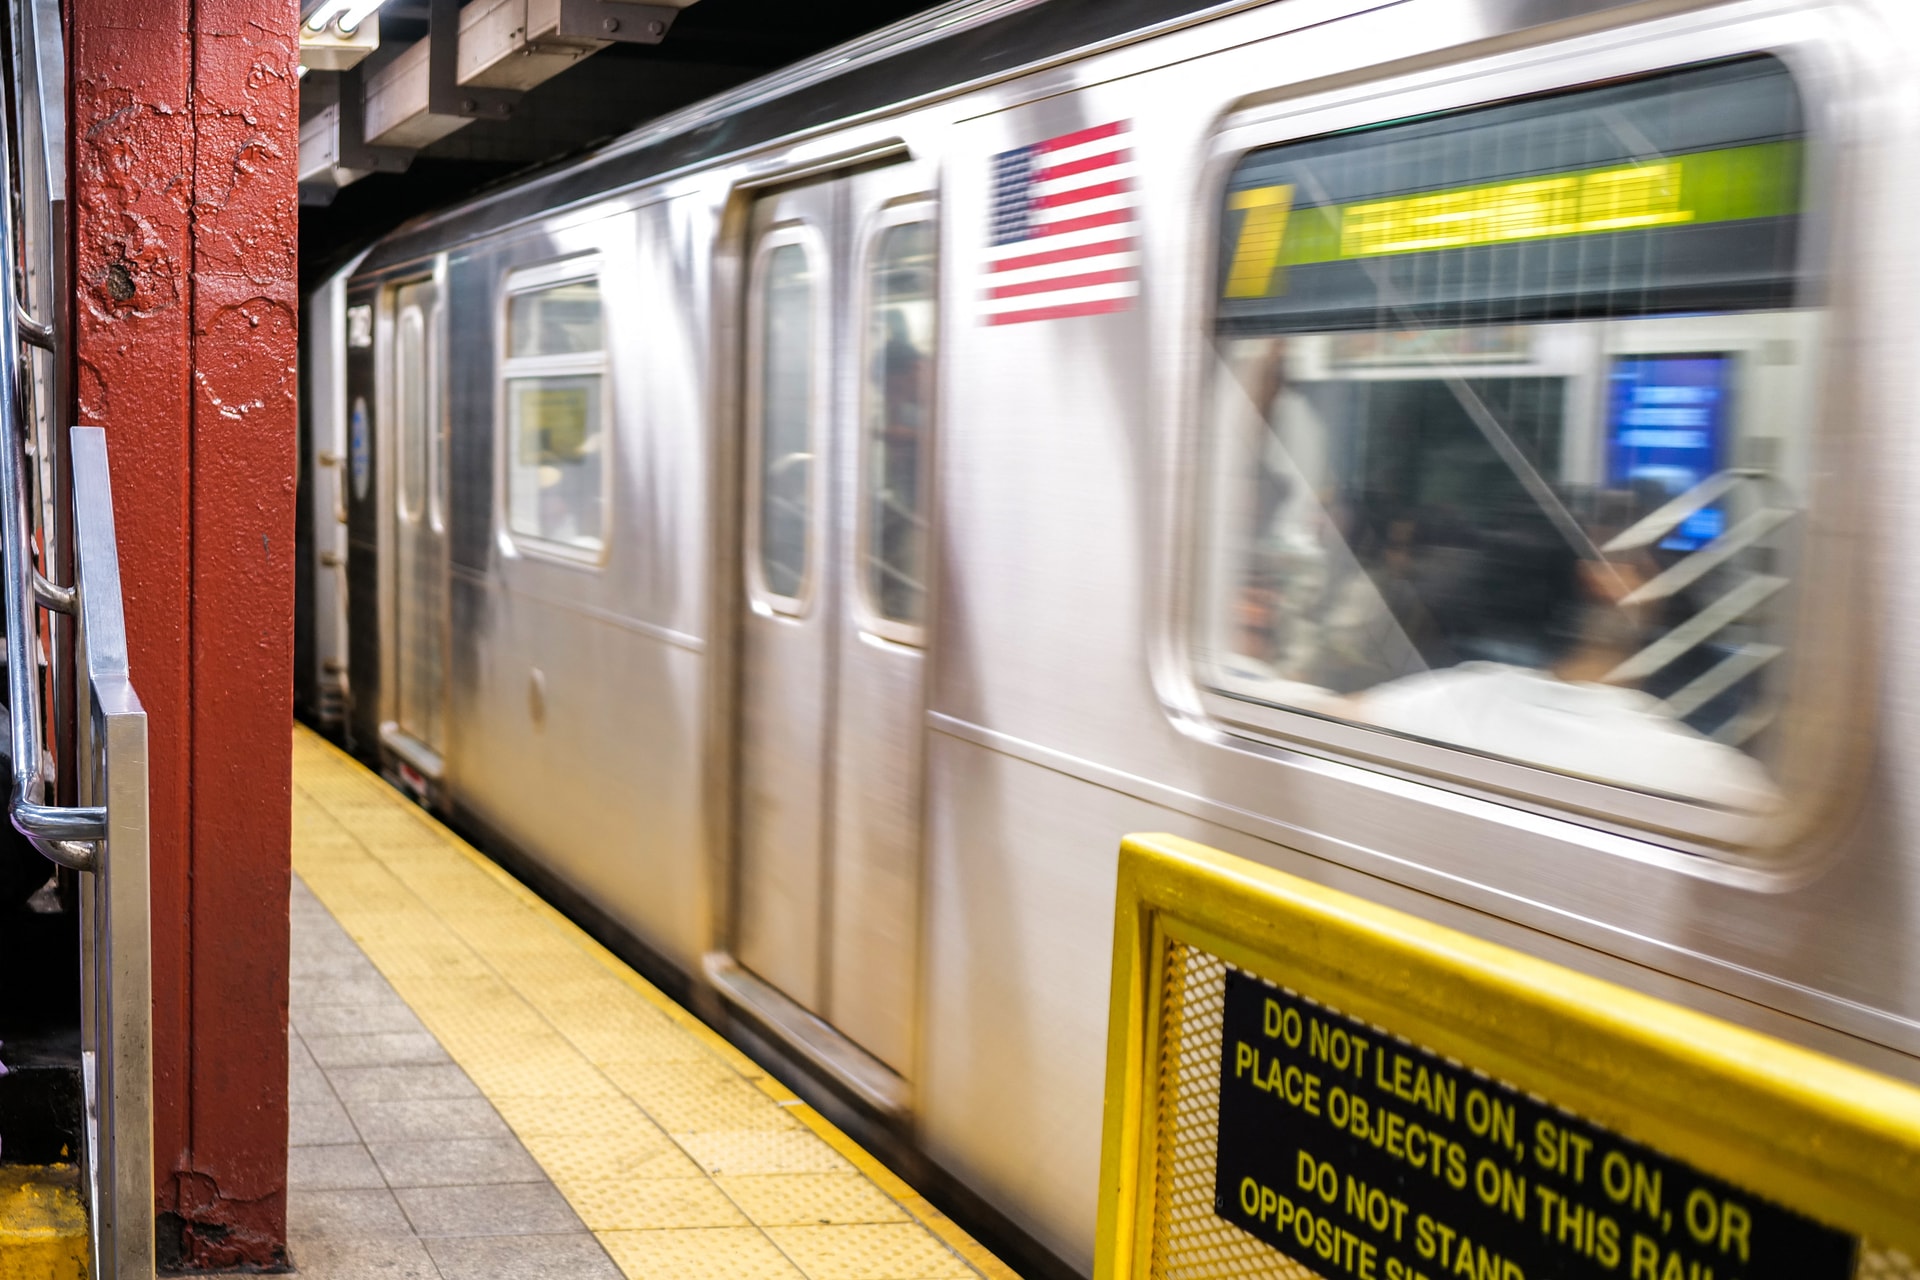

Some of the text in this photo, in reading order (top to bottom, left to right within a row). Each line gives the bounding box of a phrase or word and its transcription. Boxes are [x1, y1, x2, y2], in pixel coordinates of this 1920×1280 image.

[1235, 1040, 1321, 1116] PLACE
[1328, 1086, 1467, 1188] OBJECTS
[1475, 1158, 1526, 1221] ON
[1535, 1183, 1620, 1268] THIS
[1264, 998, 1751, 1261] DO NOT LEAN ON, SIT ON, OR
[1297, 1149, 1338, 1203] DO
[1346, 1175, 1409, 1241] NOT
[1240, 1176, 1377, 1280] OPPOSITE
